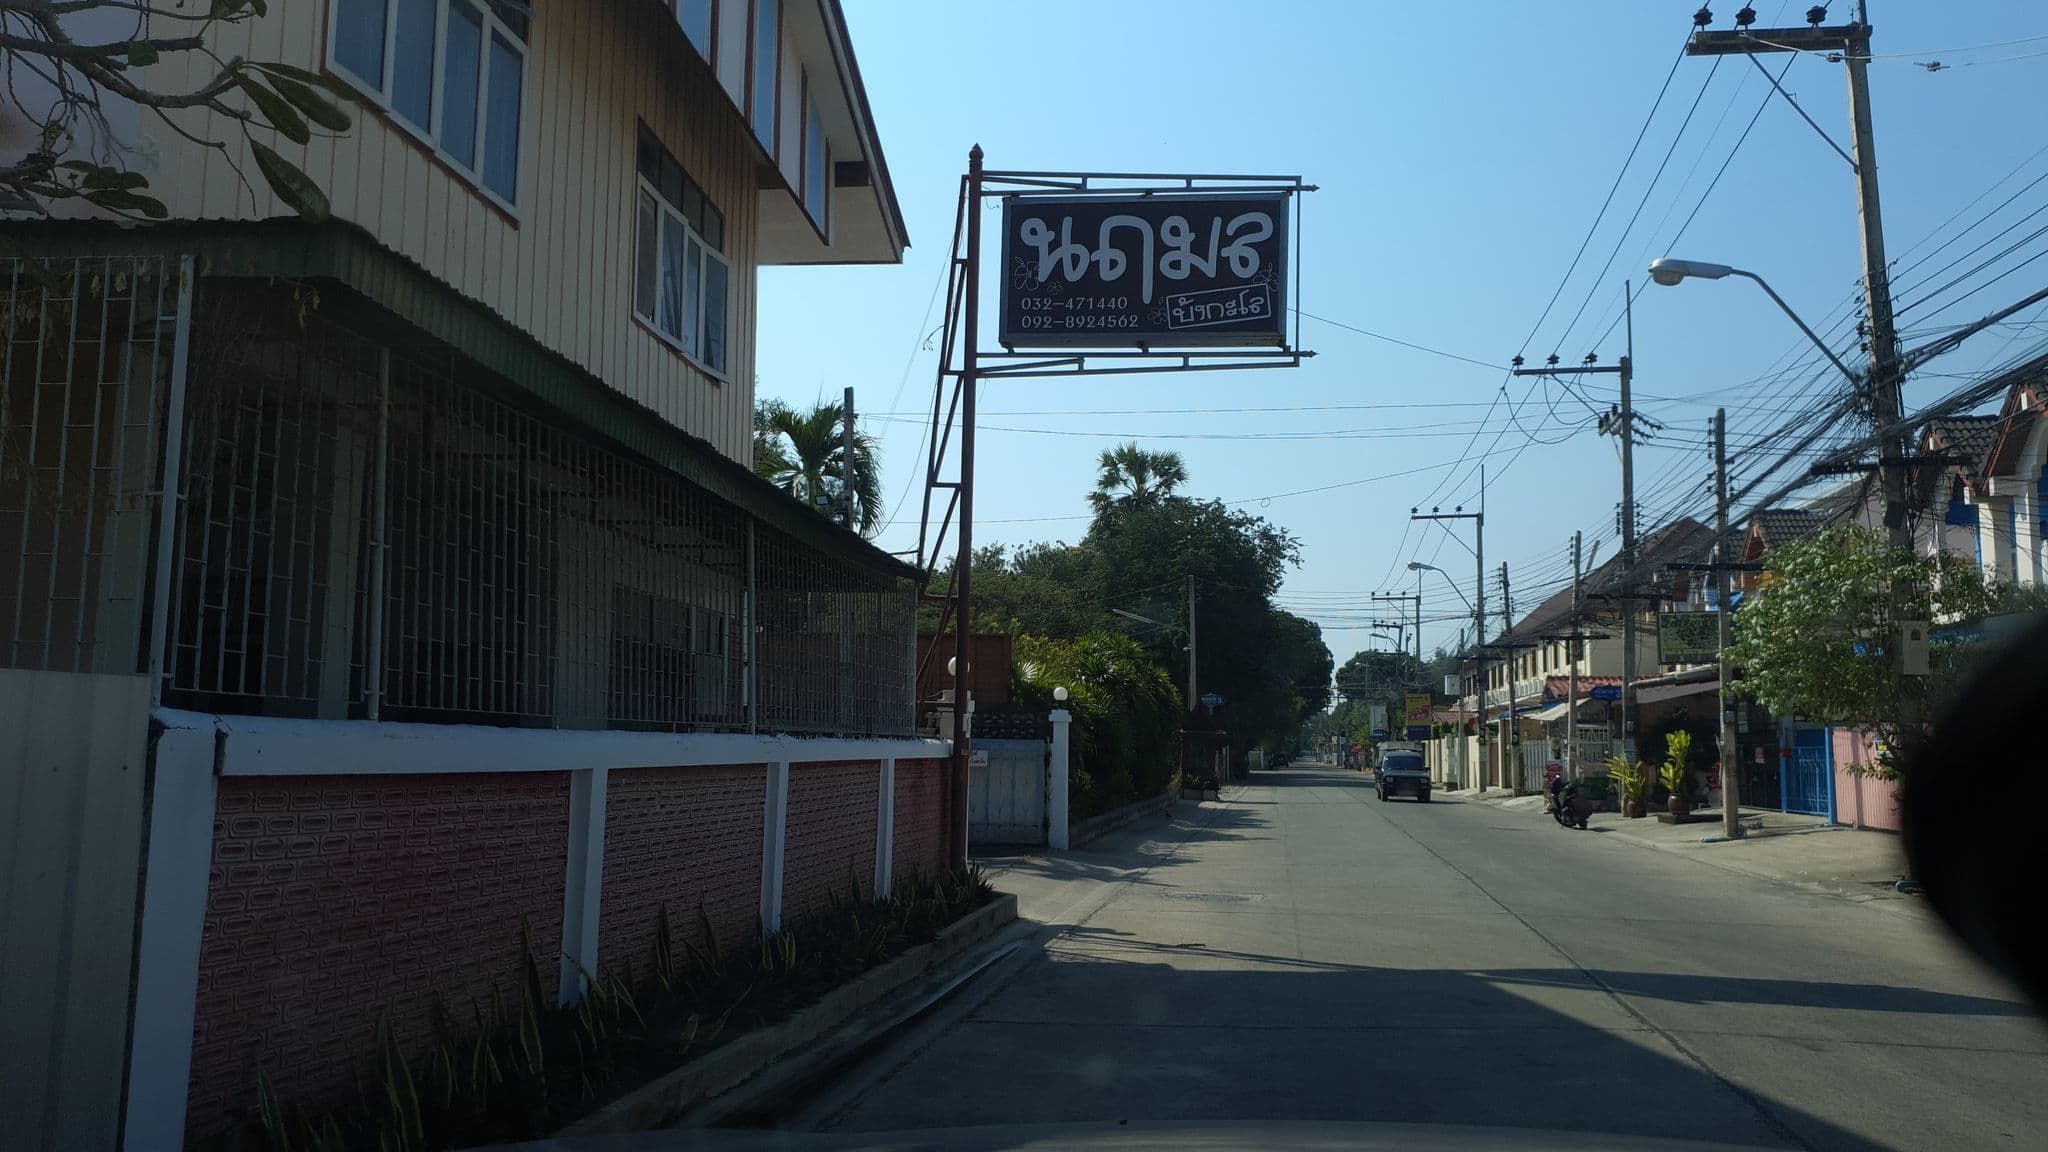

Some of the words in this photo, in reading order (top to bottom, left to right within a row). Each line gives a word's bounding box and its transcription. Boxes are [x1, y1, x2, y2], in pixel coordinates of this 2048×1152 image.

[1020, 211, 1274, 305] นฤมล
[1021, 296, 1128, 310] 032-471440
[1172, 288, 1265, 323] บังกะโล
[1021, 314, 1139, 329] 092-8924562
